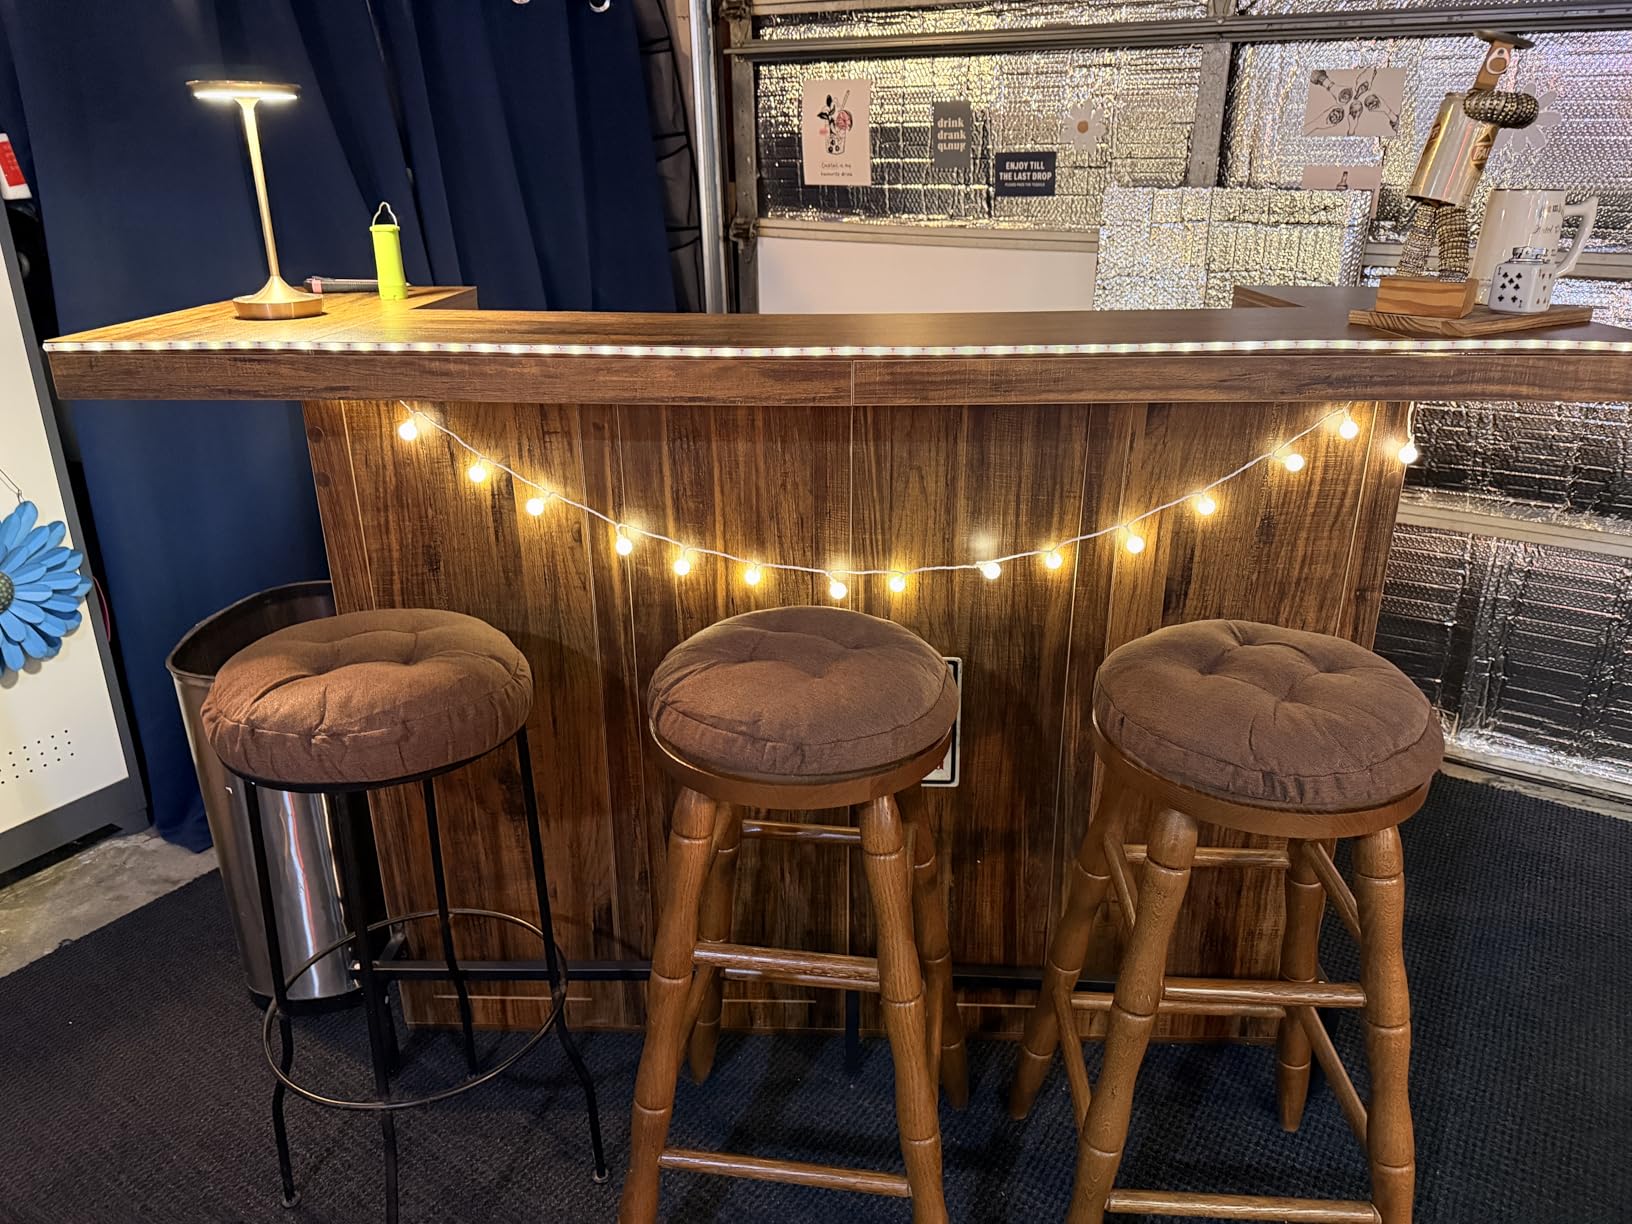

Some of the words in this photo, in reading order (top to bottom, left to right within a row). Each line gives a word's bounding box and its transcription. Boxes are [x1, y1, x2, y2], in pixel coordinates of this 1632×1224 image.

[937, 117, 965, 128] drink
[937, 129, 966, 140] drank
[1005, 161, 1029, 170] ENJOY
[1029, 161, 1045, 170] TILL
[999, 171, 1013, 180] THE
[1013, 171, 1031, 180] LAST
[1031, 171, 1052, 180] DROP
